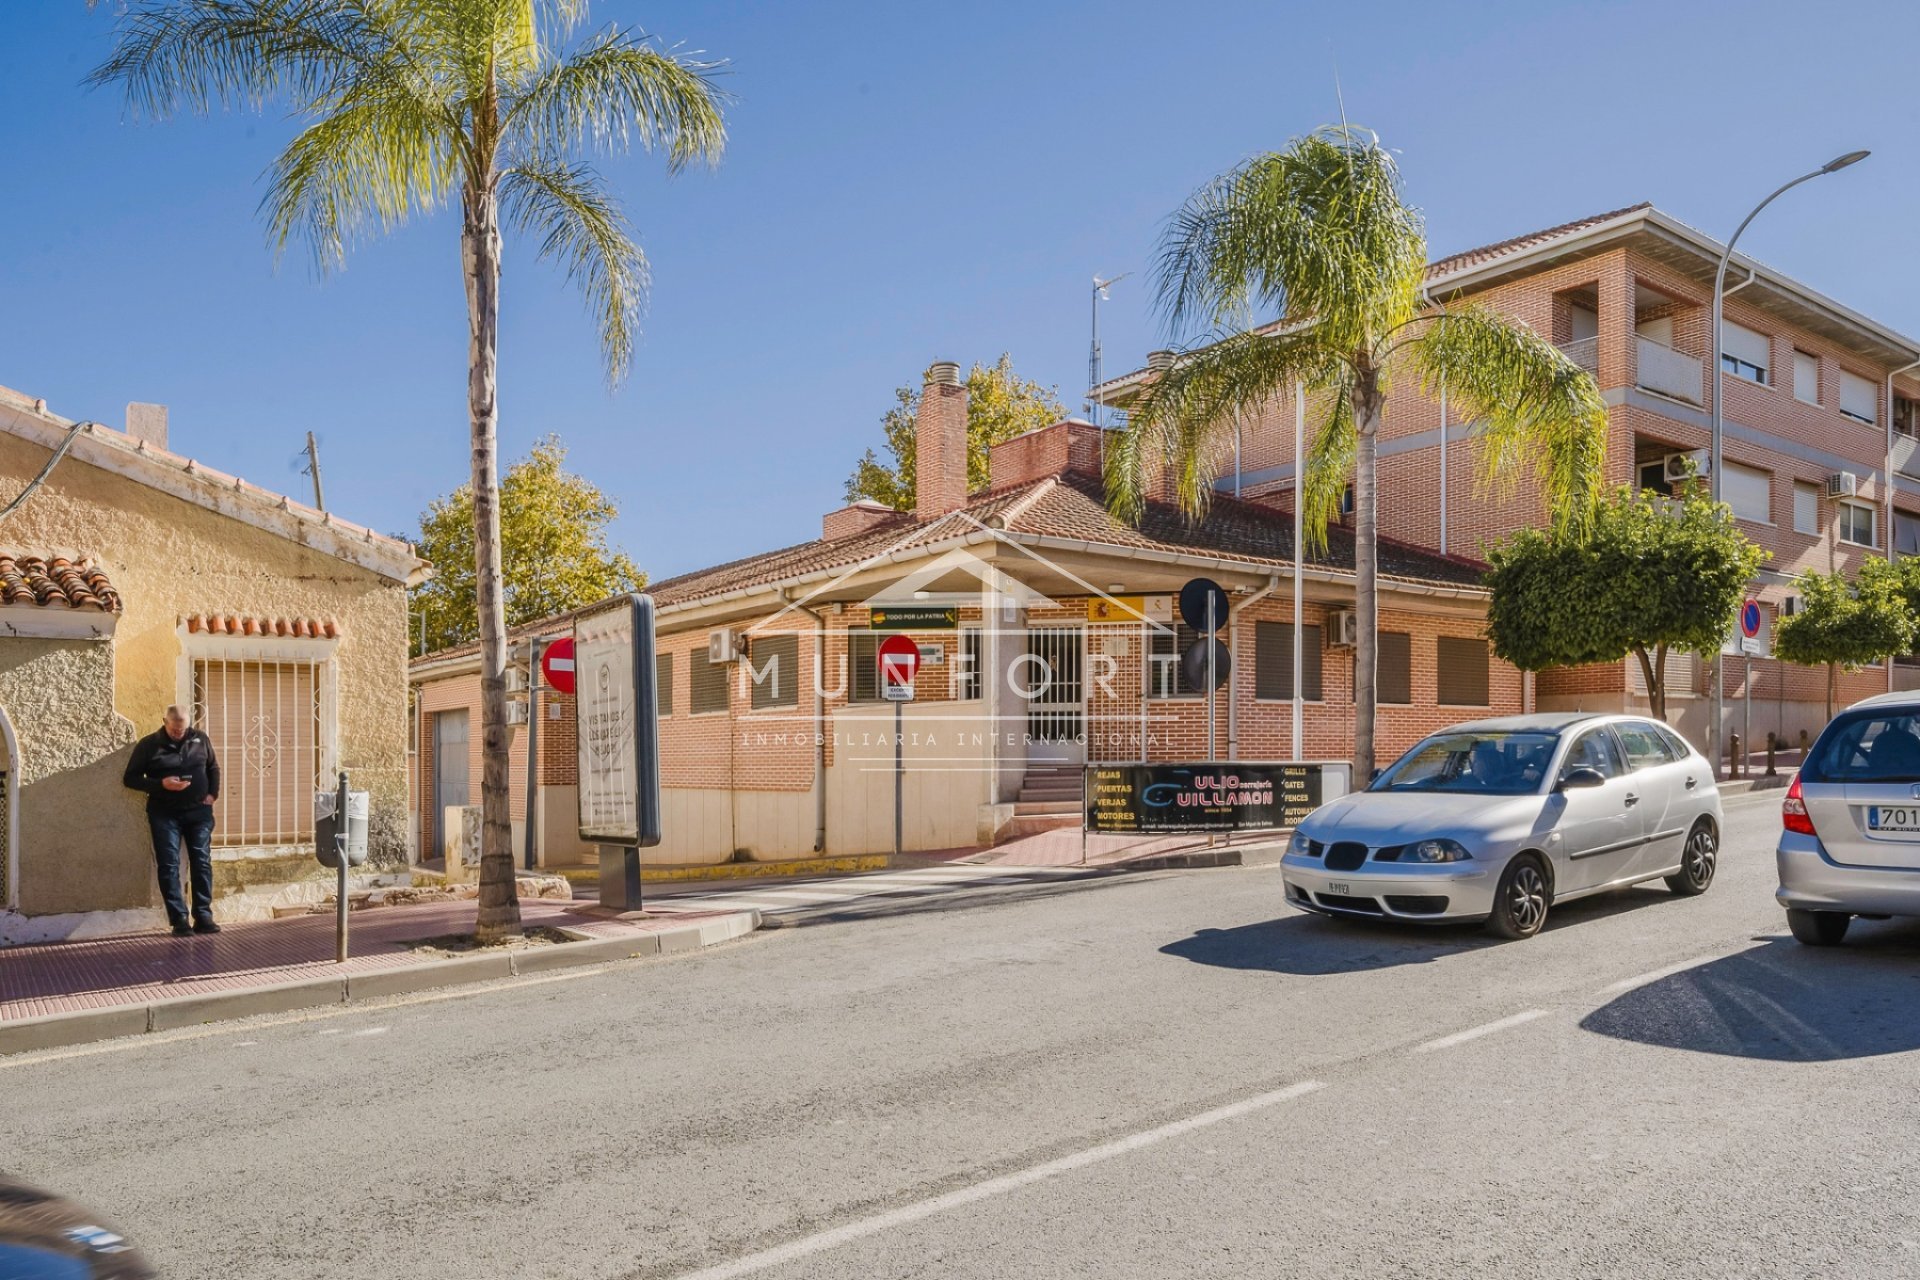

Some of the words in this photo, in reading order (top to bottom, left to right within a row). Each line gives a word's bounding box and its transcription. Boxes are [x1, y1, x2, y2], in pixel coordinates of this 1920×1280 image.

[886, 613, 903, 621] TODO
[924, 612, 946, 620] PATRIA
[1097, 771, 1121, 779] REJAS
[1284, 767, 1306, 776] GRILLS
[1096, 784, 1133, 793] PUERTAS
[1284, 781, 1305, 789] GATES
[1097, 798, 1127, 807] VERJAS
[1284, 794, 1309, 802] FENCES
[1097, 812, 1135, 820] MOTORES
[1284, 807, 1316, 816] AUTOMAT
[1882, 809, 1917, 825] 701
